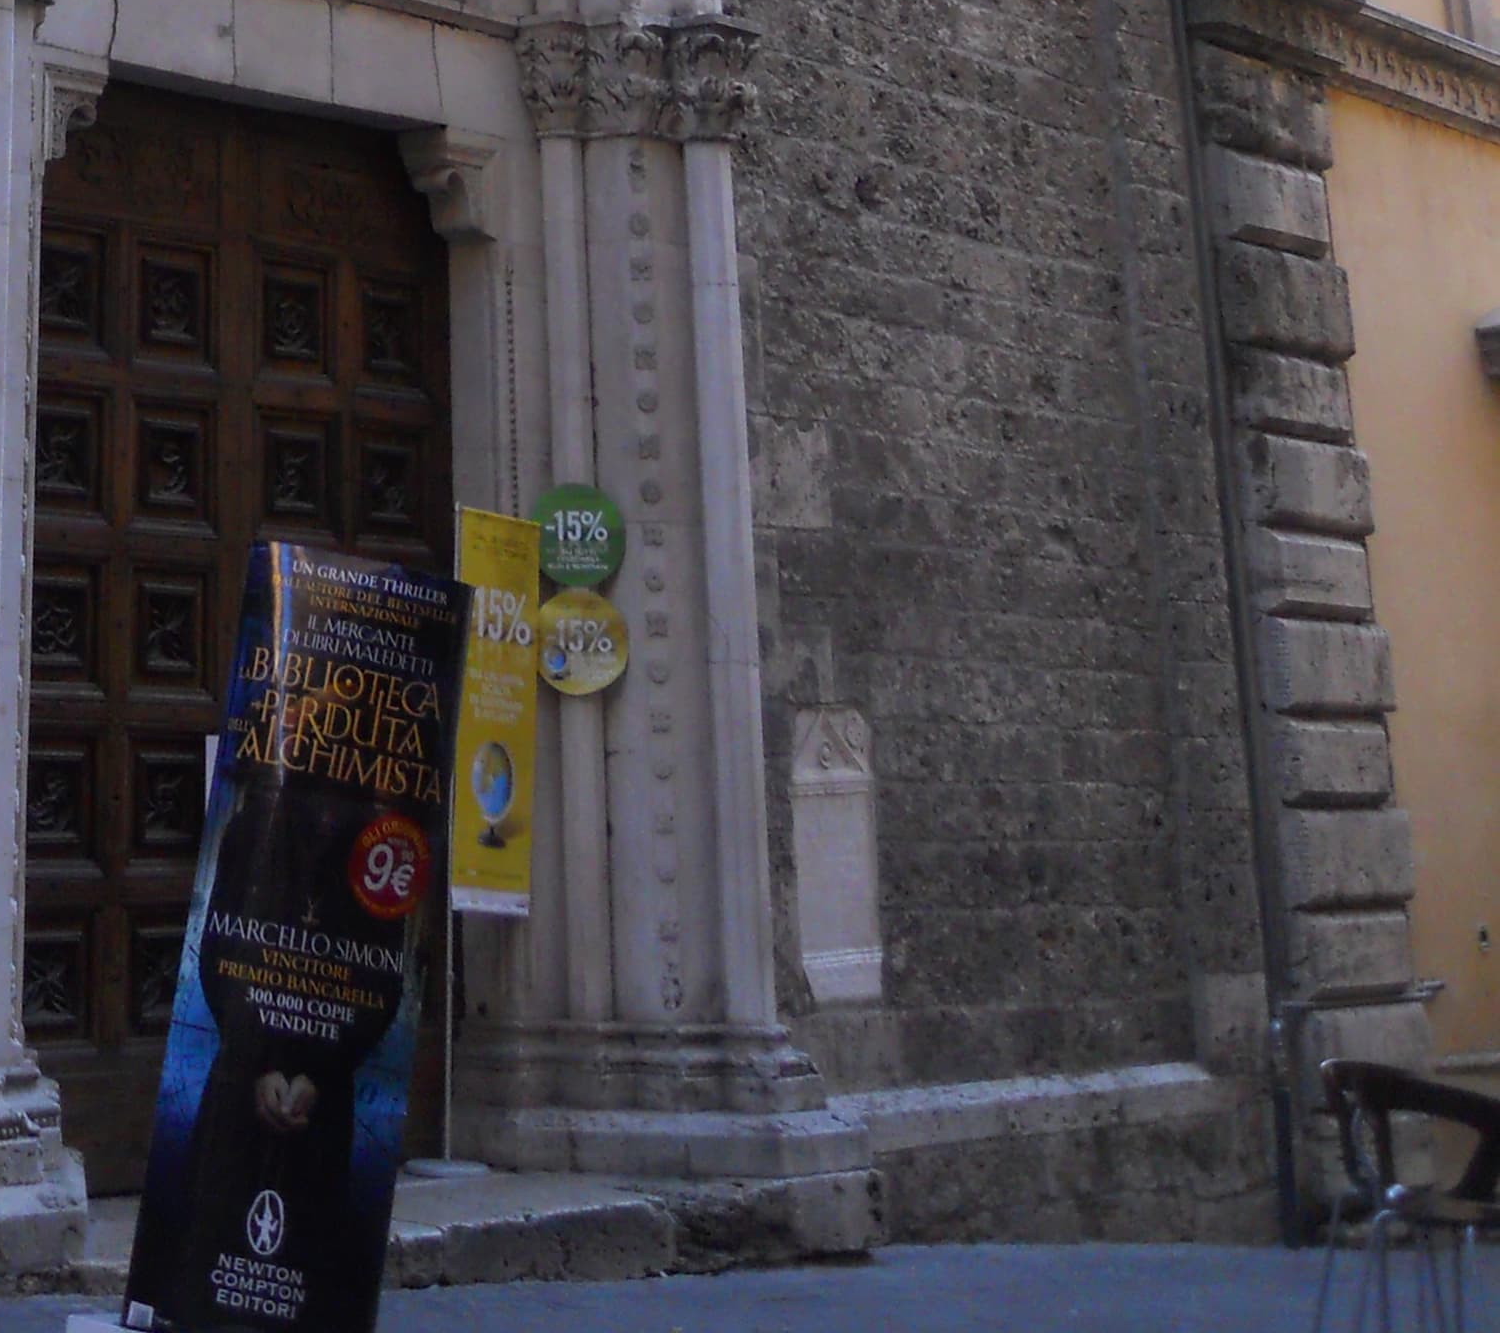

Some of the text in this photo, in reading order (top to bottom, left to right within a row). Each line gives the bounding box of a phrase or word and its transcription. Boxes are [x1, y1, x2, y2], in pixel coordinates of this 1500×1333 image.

[545, 510, 608, 541] -15%
[292, 560, 448, 605] UN GRANDE THRILLER
[356, 590, 383, 606] DEL
[307, 614, 417, 653] IL MERCANTE
[473, 586, 532, 646] 15%
[283, 628, 435, 677] DI LIBRI MALEDETTI
[546, 619, 613, 653] -15%
[251, 646, 441, 721] BIBLIOTECA
[258, 688, 425, 759] PERDUTA
[236, 715, 442, 805] ALCHIMISTA
[208, 910, 405, 974] MARCELLO SIMONI
[261, 947, 351, 982] VINCITORE
[217, 958, 386, 1011] PREMIO BANCARELLA
[245, 986, 356, 1023] 300.000 COPIE
[258, 1008, 340, 1040] VENDUTE
[210, 1269, 306, 1303] COMPTON
[217, 1252, 303, 1286] NEWTON
[216, 1288, 297, 1320] EDITORI
